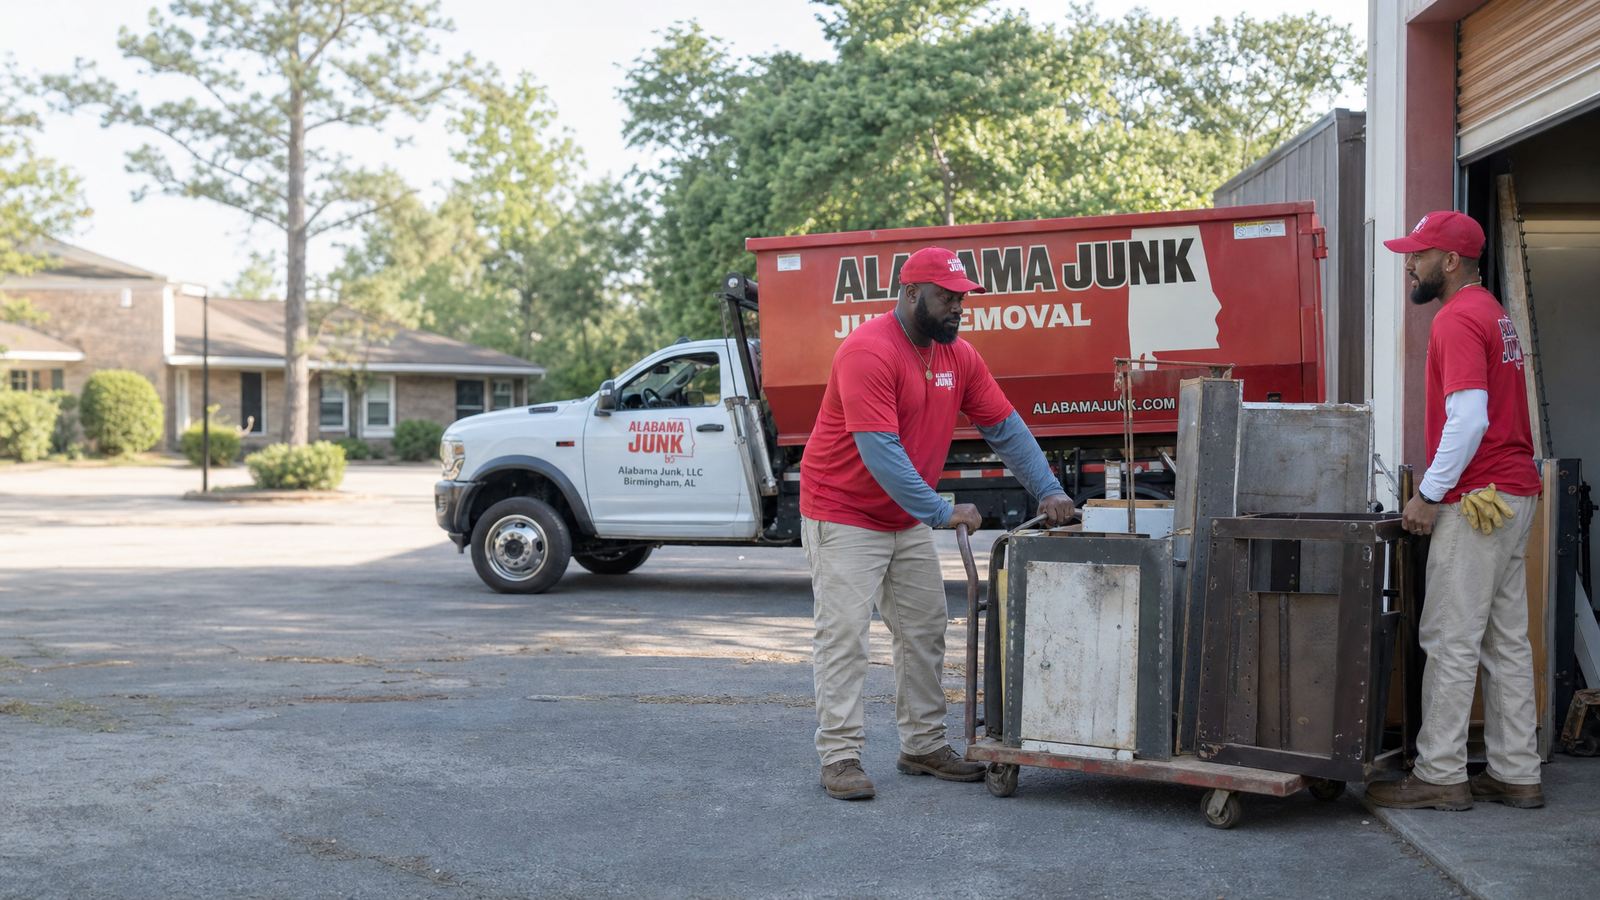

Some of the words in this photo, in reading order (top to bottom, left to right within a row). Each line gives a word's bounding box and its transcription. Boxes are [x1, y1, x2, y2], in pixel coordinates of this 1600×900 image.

[833, 244, 1058, 304] ALAAMA
[1062, 237, 1197, 290] JUNK
[958, 303, 1092, 332] EMOVAL
[1033, 398, 1175, 414] ALABAMAJUNK.COM
[628, 421, 684, 433] ALABAMA
[628, 434, 684, 454] JUNK
[618, 466, 658, 475] Alabama
[660, 467, 685, 477] Junk,
[686, 468, 703, 477] LLC
[624, 477, 682, 488] Birmingham,
[684, 479, 696, 487] AL
